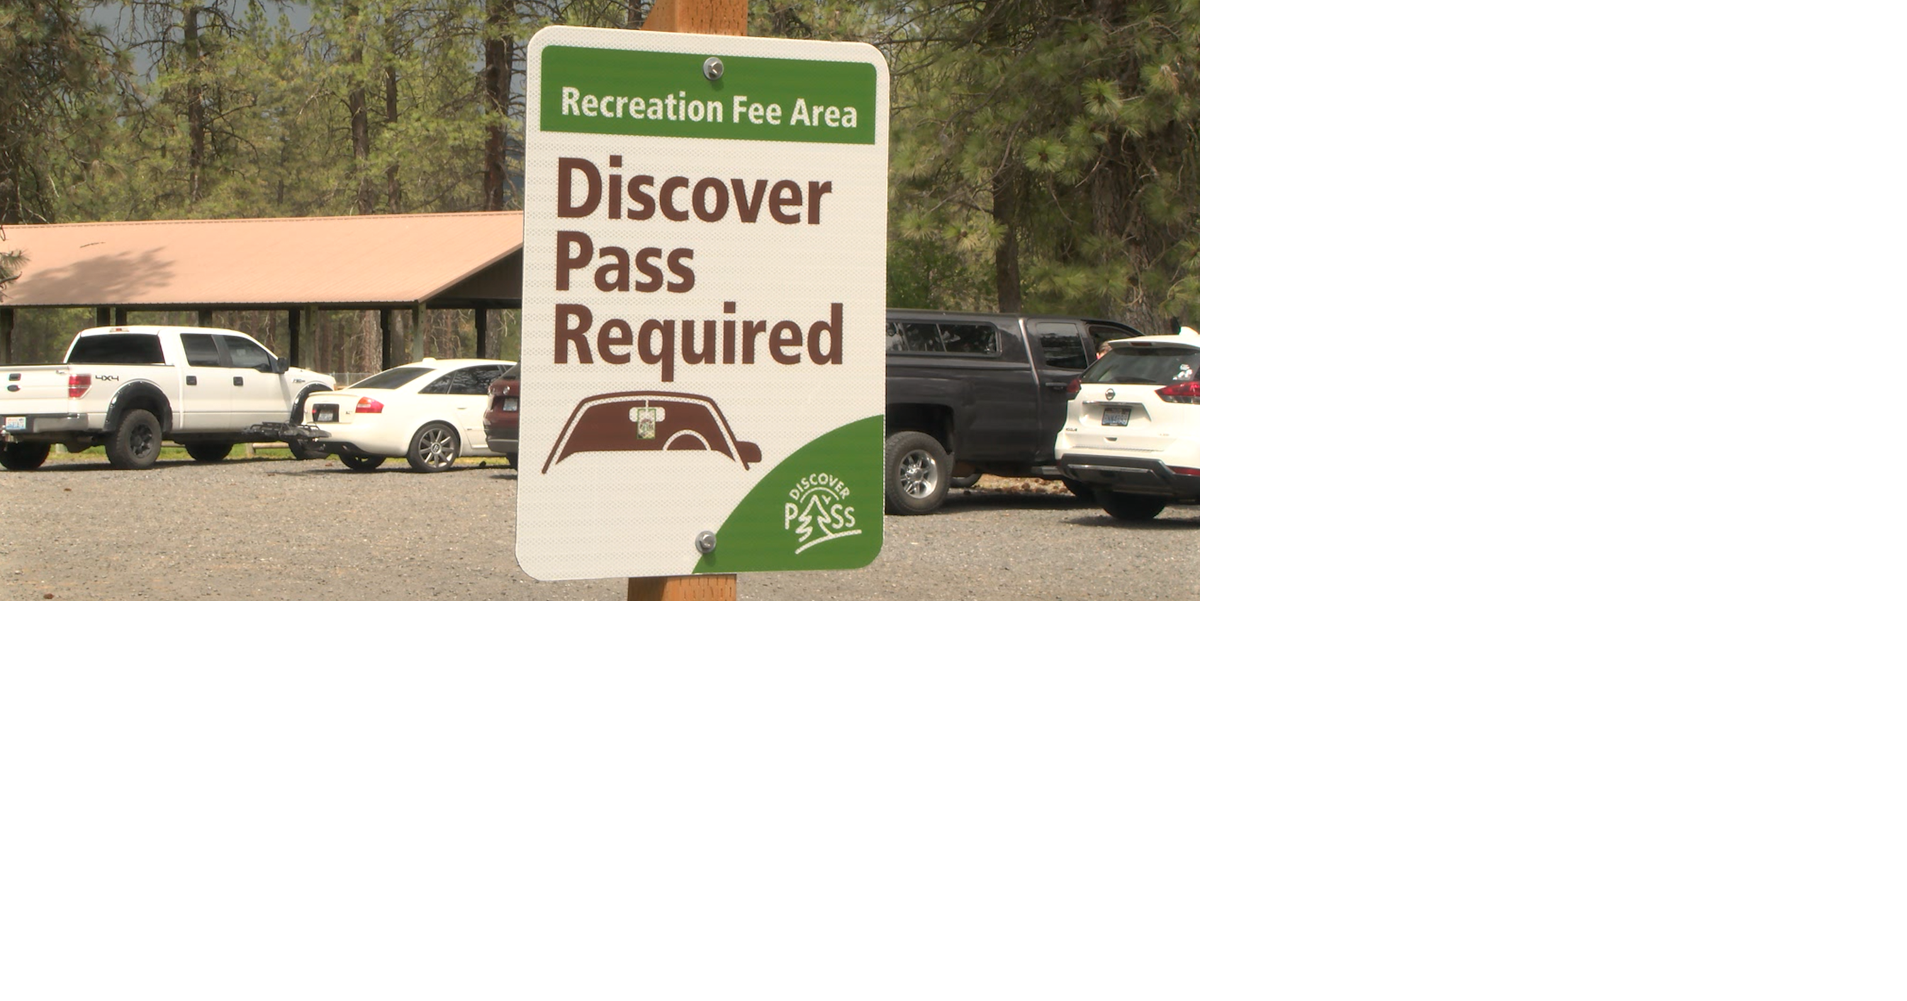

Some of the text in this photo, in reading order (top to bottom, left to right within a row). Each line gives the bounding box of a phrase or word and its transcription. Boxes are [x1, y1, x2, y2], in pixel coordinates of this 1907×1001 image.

[561, 86, 858, 128] Recreation Fee Area
[557, 154, 832, 225] Discover
[555, 230, 696, 294] Pass
[554, 301, 844, 383] Required
[788, 472, 850, 501] DISCOVER
